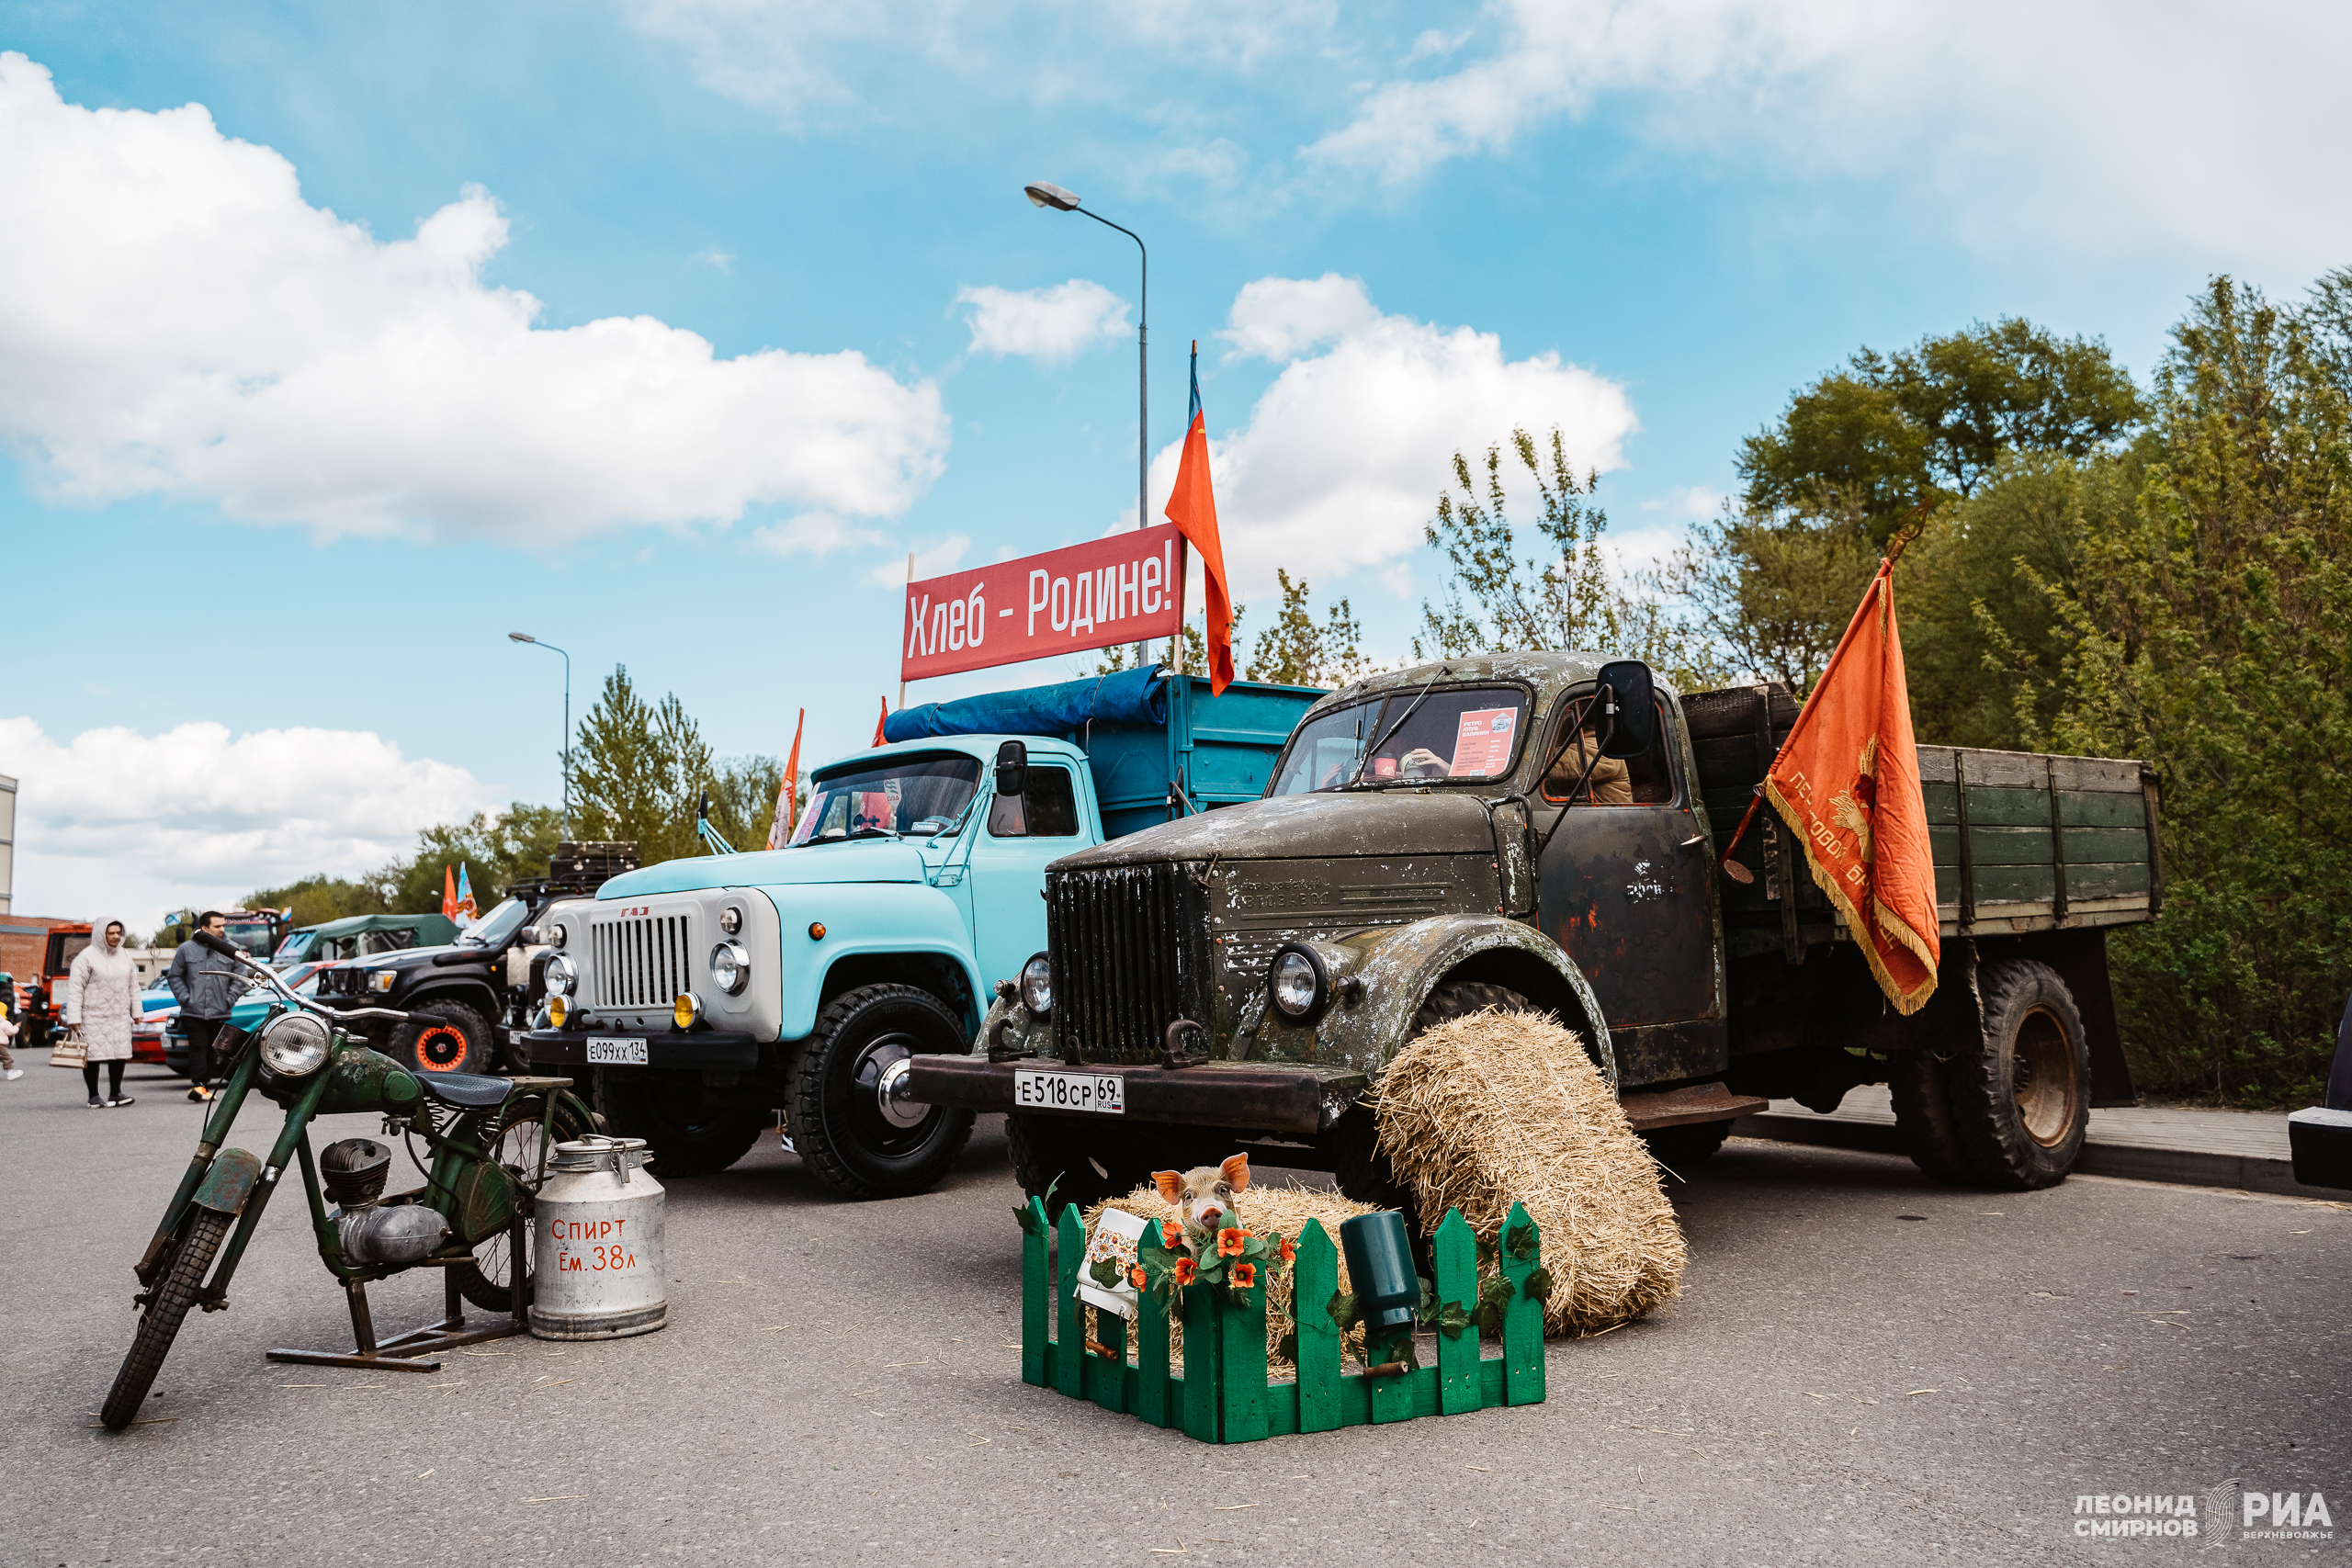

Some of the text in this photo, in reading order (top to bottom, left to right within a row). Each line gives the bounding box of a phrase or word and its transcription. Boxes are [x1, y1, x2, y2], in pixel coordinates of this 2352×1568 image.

[907, 581, 985, 659] Хлеб
[1027, 538, 1172, 637] Родине!
[620, 906, 650, 918] ГАЗ
[628, 1042, 647, 1057] 134
[1097, 1078, 1116, 1101] 69
[1097, 1100, 1112, 1110] RUS
